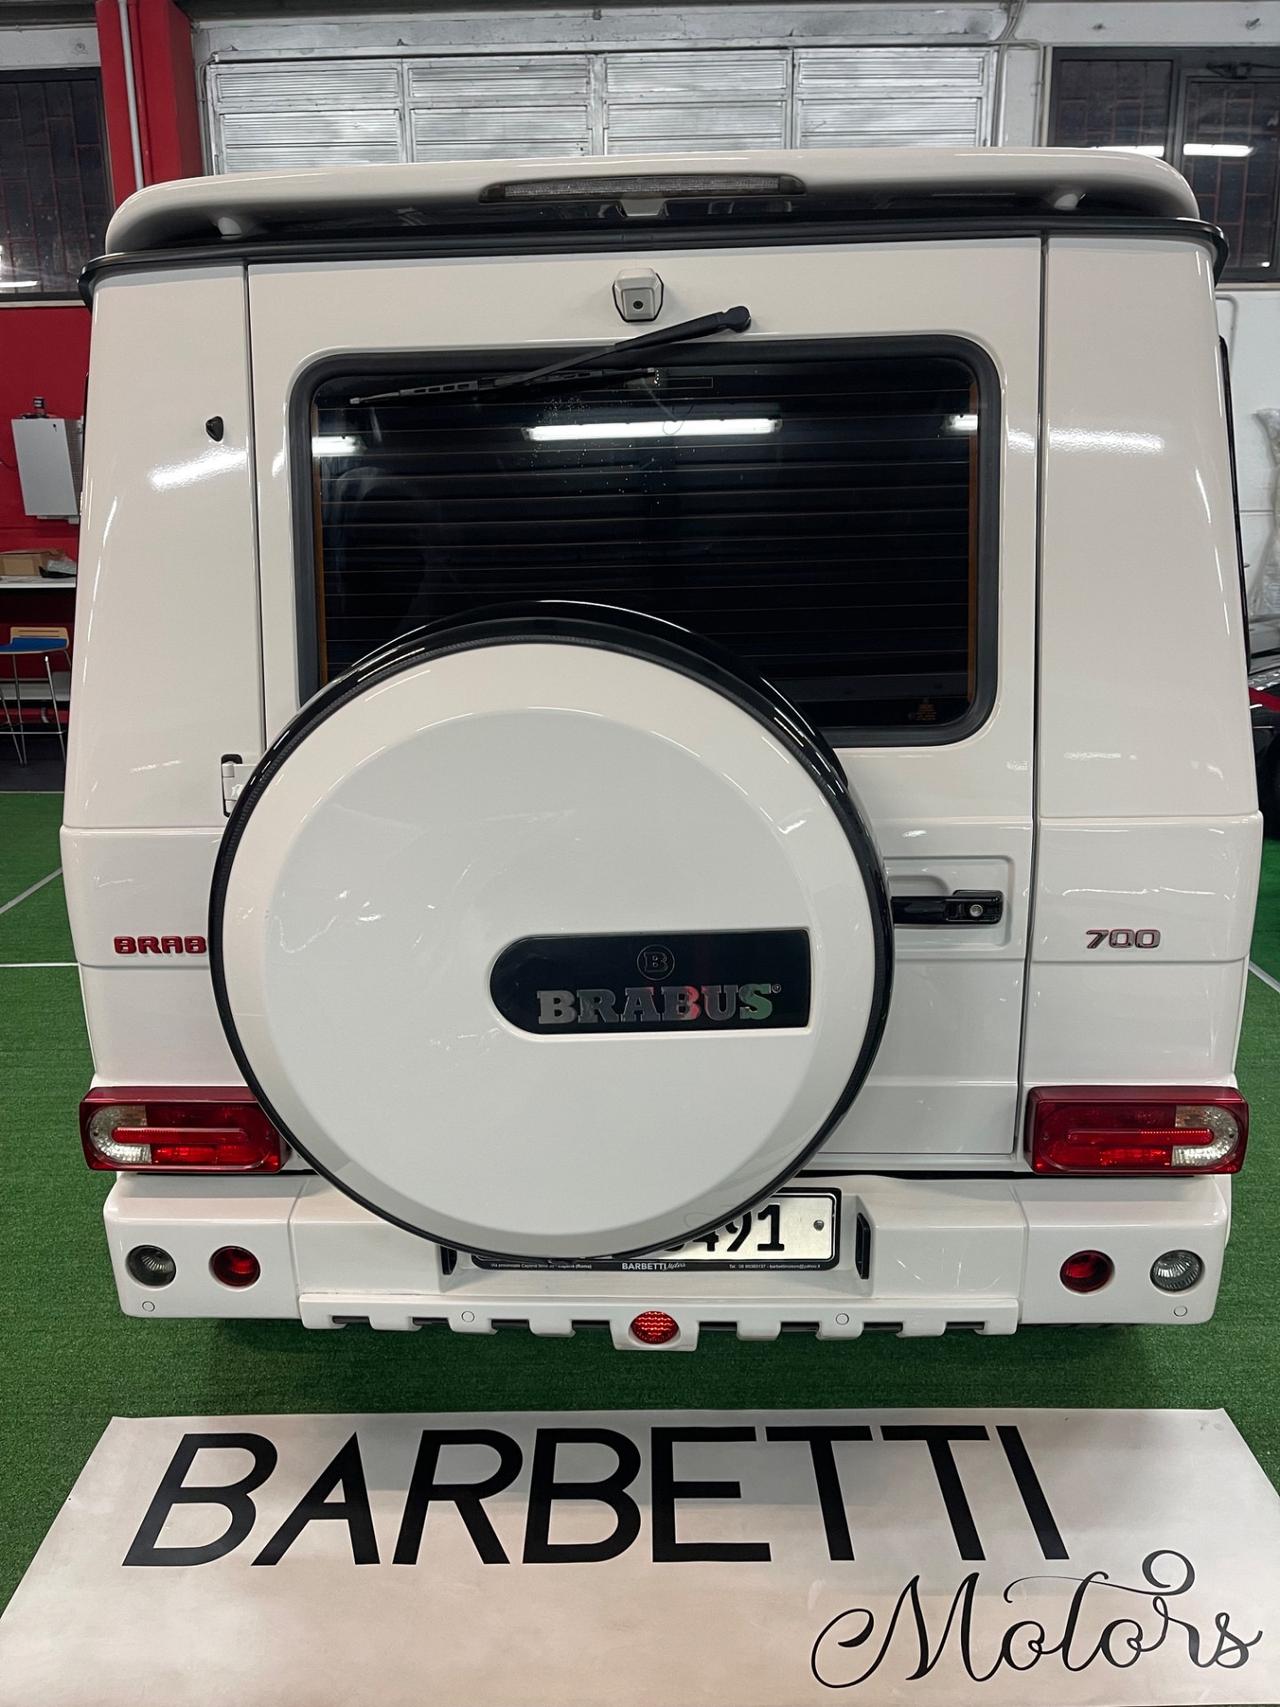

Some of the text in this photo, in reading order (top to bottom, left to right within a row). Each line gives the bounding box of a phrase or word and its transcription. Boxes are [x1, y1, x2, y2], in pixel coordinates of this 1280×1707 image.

[1086, 928, 1161, 949] 700
[664, 1203, 784, 1252] 491
[621, 1262, 667, 1271] BARBETTI
[122, 1425, 1070, 1567] BARBETTI
[811, 1549, 1263, 1688] Motors
